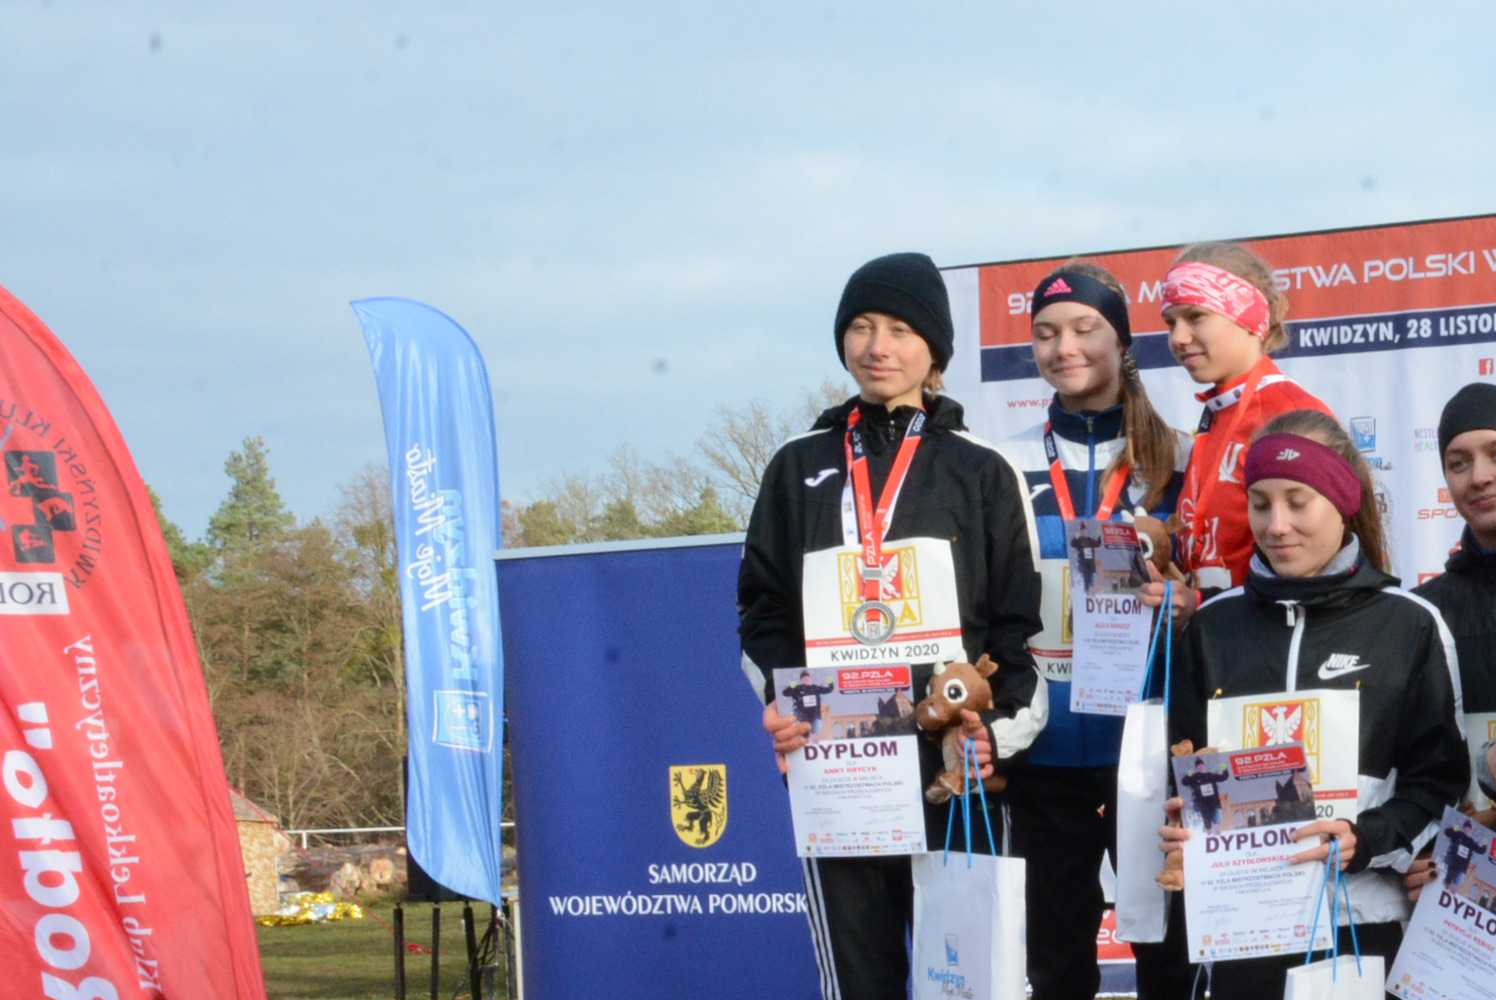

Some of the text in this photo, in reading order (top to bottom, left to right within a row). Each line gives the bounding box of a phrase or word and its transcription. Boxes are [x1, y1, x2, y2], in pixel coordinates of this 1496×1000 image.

[1363, 251, 1475, 284] POLSKI
[1299, 321, 1400, 347] KWIDZYN,
[1406, 318, 1432, 340] 28
[1417, 508, 1460, 520] SPO
[1085, 598, 1142, 615] DYPLOM
[830, 643, 940, 662] KWIDZYN 2020
[1326, 652, 1360, 668] NIKE
[804, 740, 898, 761] DYPLOM
[1205, 827, 1298, 854] DYPLOM
[648, 862, 757, 887] SAMORZĄD
[549, 890, 809, 917] WOJEWÓDZTWA POMORSK
